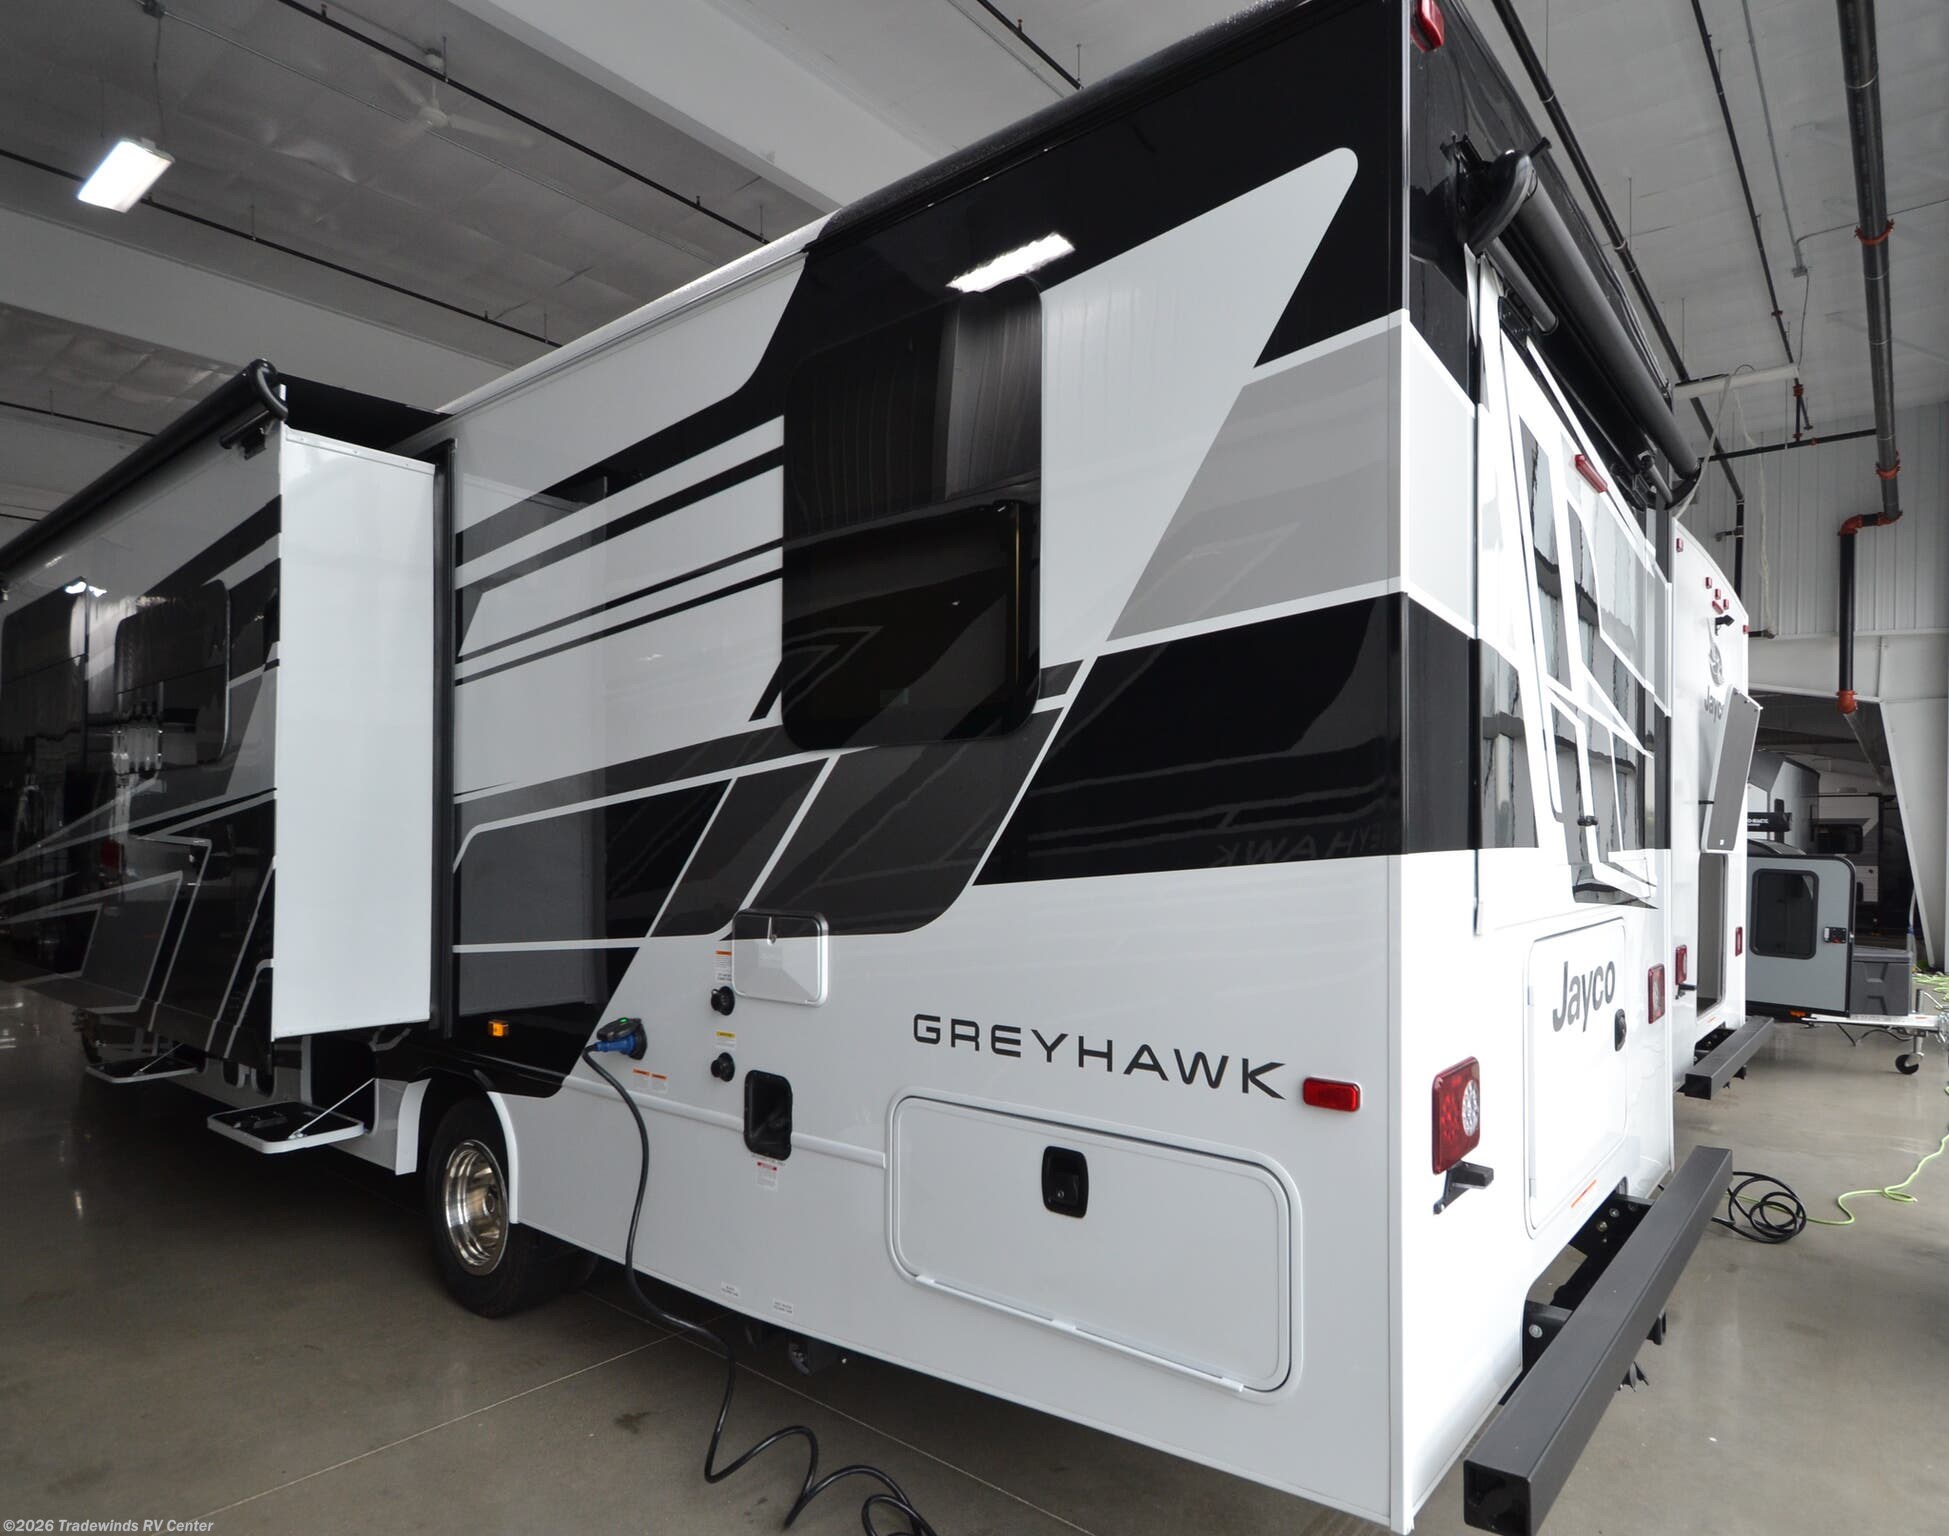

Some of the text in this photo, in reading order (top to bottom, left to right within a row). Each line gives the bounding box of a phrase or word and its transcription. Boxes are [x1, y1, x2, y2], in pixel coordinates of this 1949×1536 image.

[1703, 685, 1725, 724] Jayc
[1552, 960, 1616, 1033] Jayco
[913, 1013, 1287, 1100] GREYHAWK
